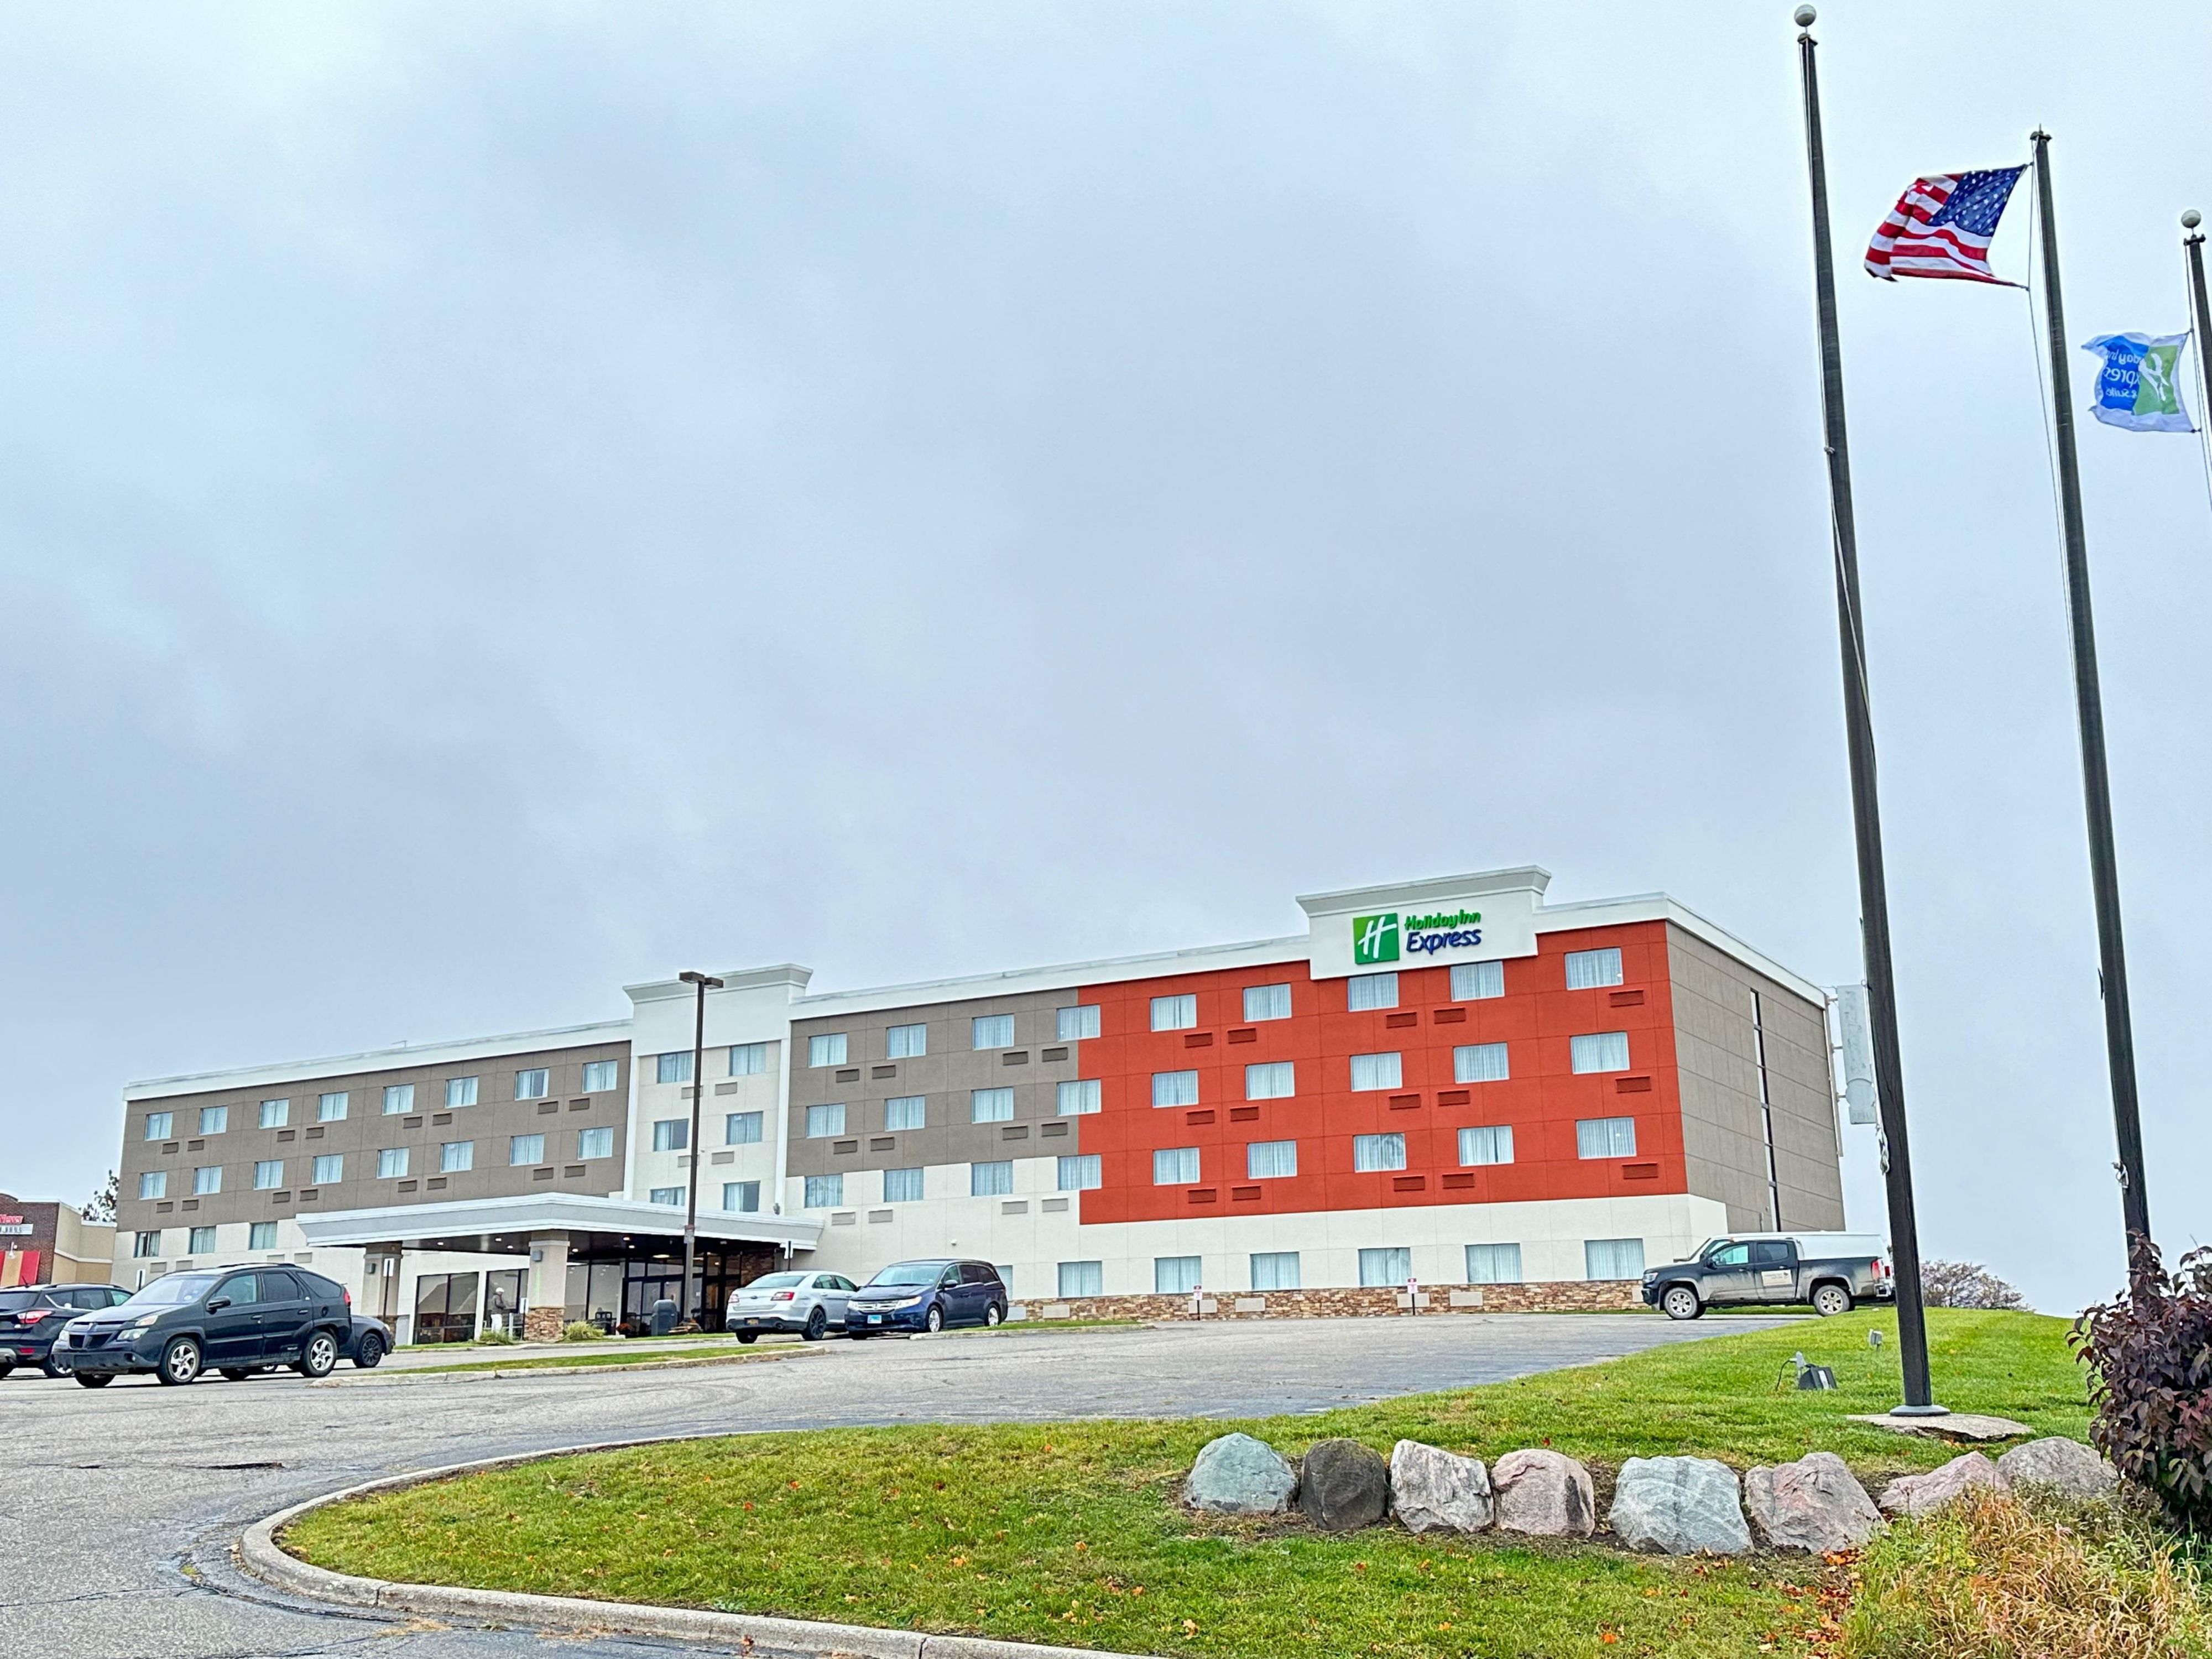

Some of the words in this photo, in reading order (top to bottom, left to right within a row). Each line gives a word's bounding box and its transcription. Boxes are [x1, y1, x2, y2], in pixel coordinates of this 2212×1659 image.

[1405, 912, 1458, 931] Holiday
[1458, 909, 1481, 925] Inn
[1406, 929, 1482, 955] Express
